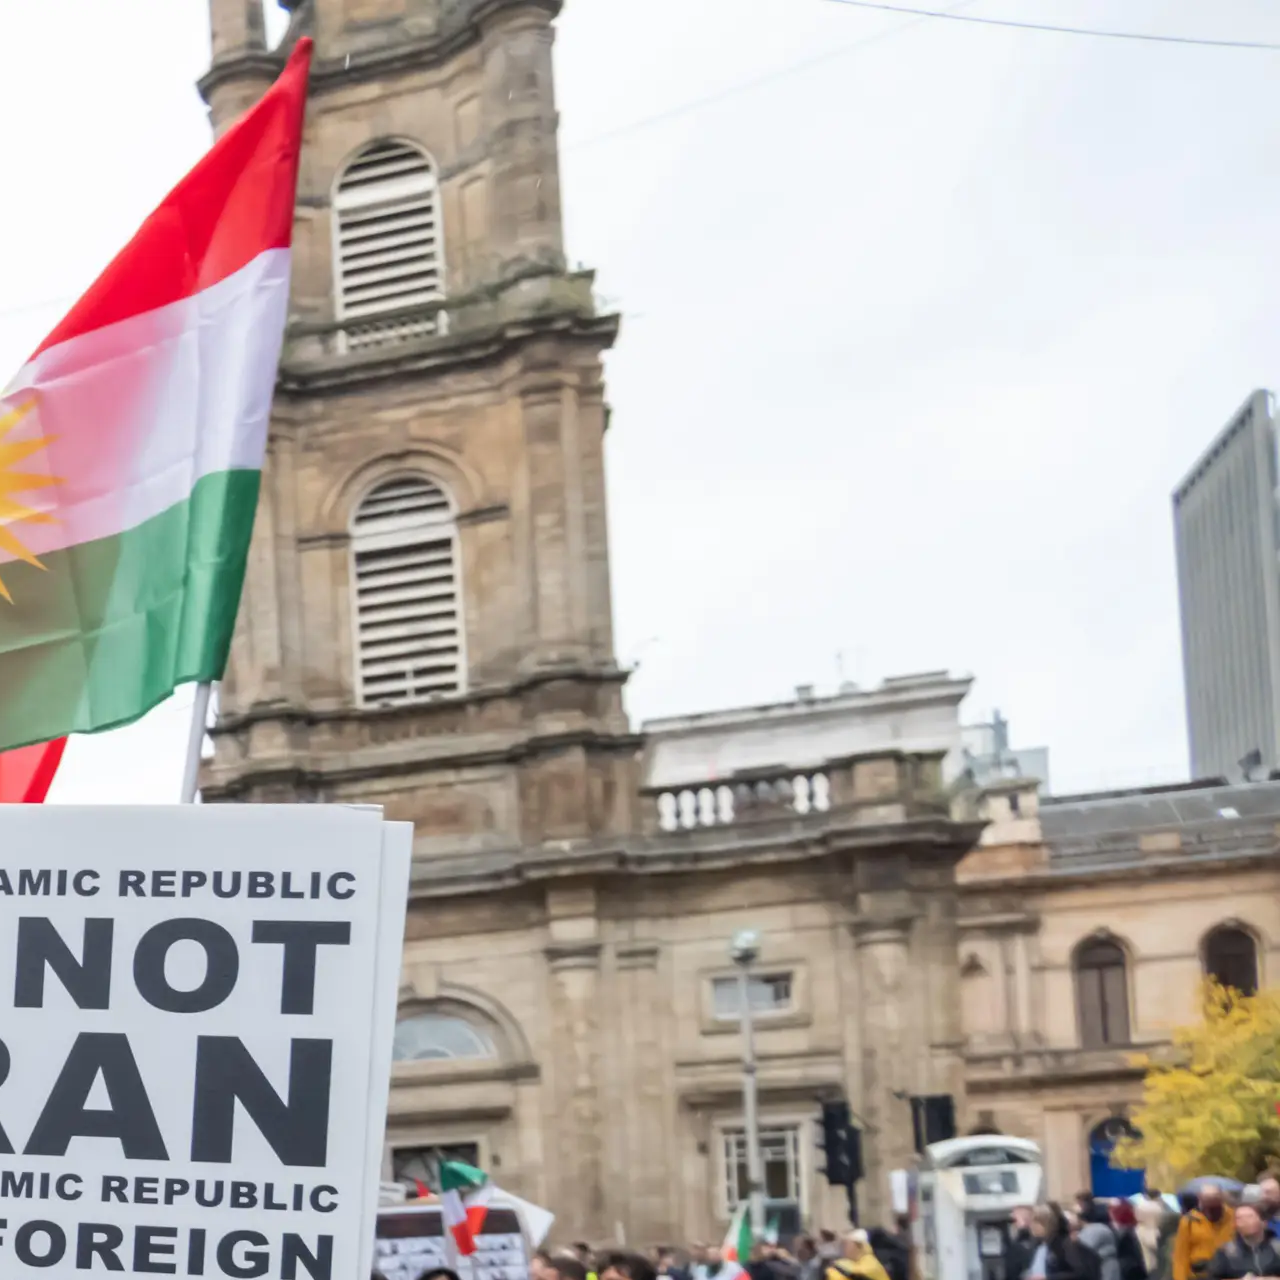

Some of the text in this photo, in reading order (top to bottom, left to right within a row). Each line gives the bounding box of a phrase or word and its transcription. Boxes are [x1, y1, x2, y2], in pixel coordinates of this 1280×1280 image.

[118, 870, 356, 900] REPUBLIC
[13, 916, 351, 1015] NOT
[101, 1176, 339, 1213] REPUBLIC
